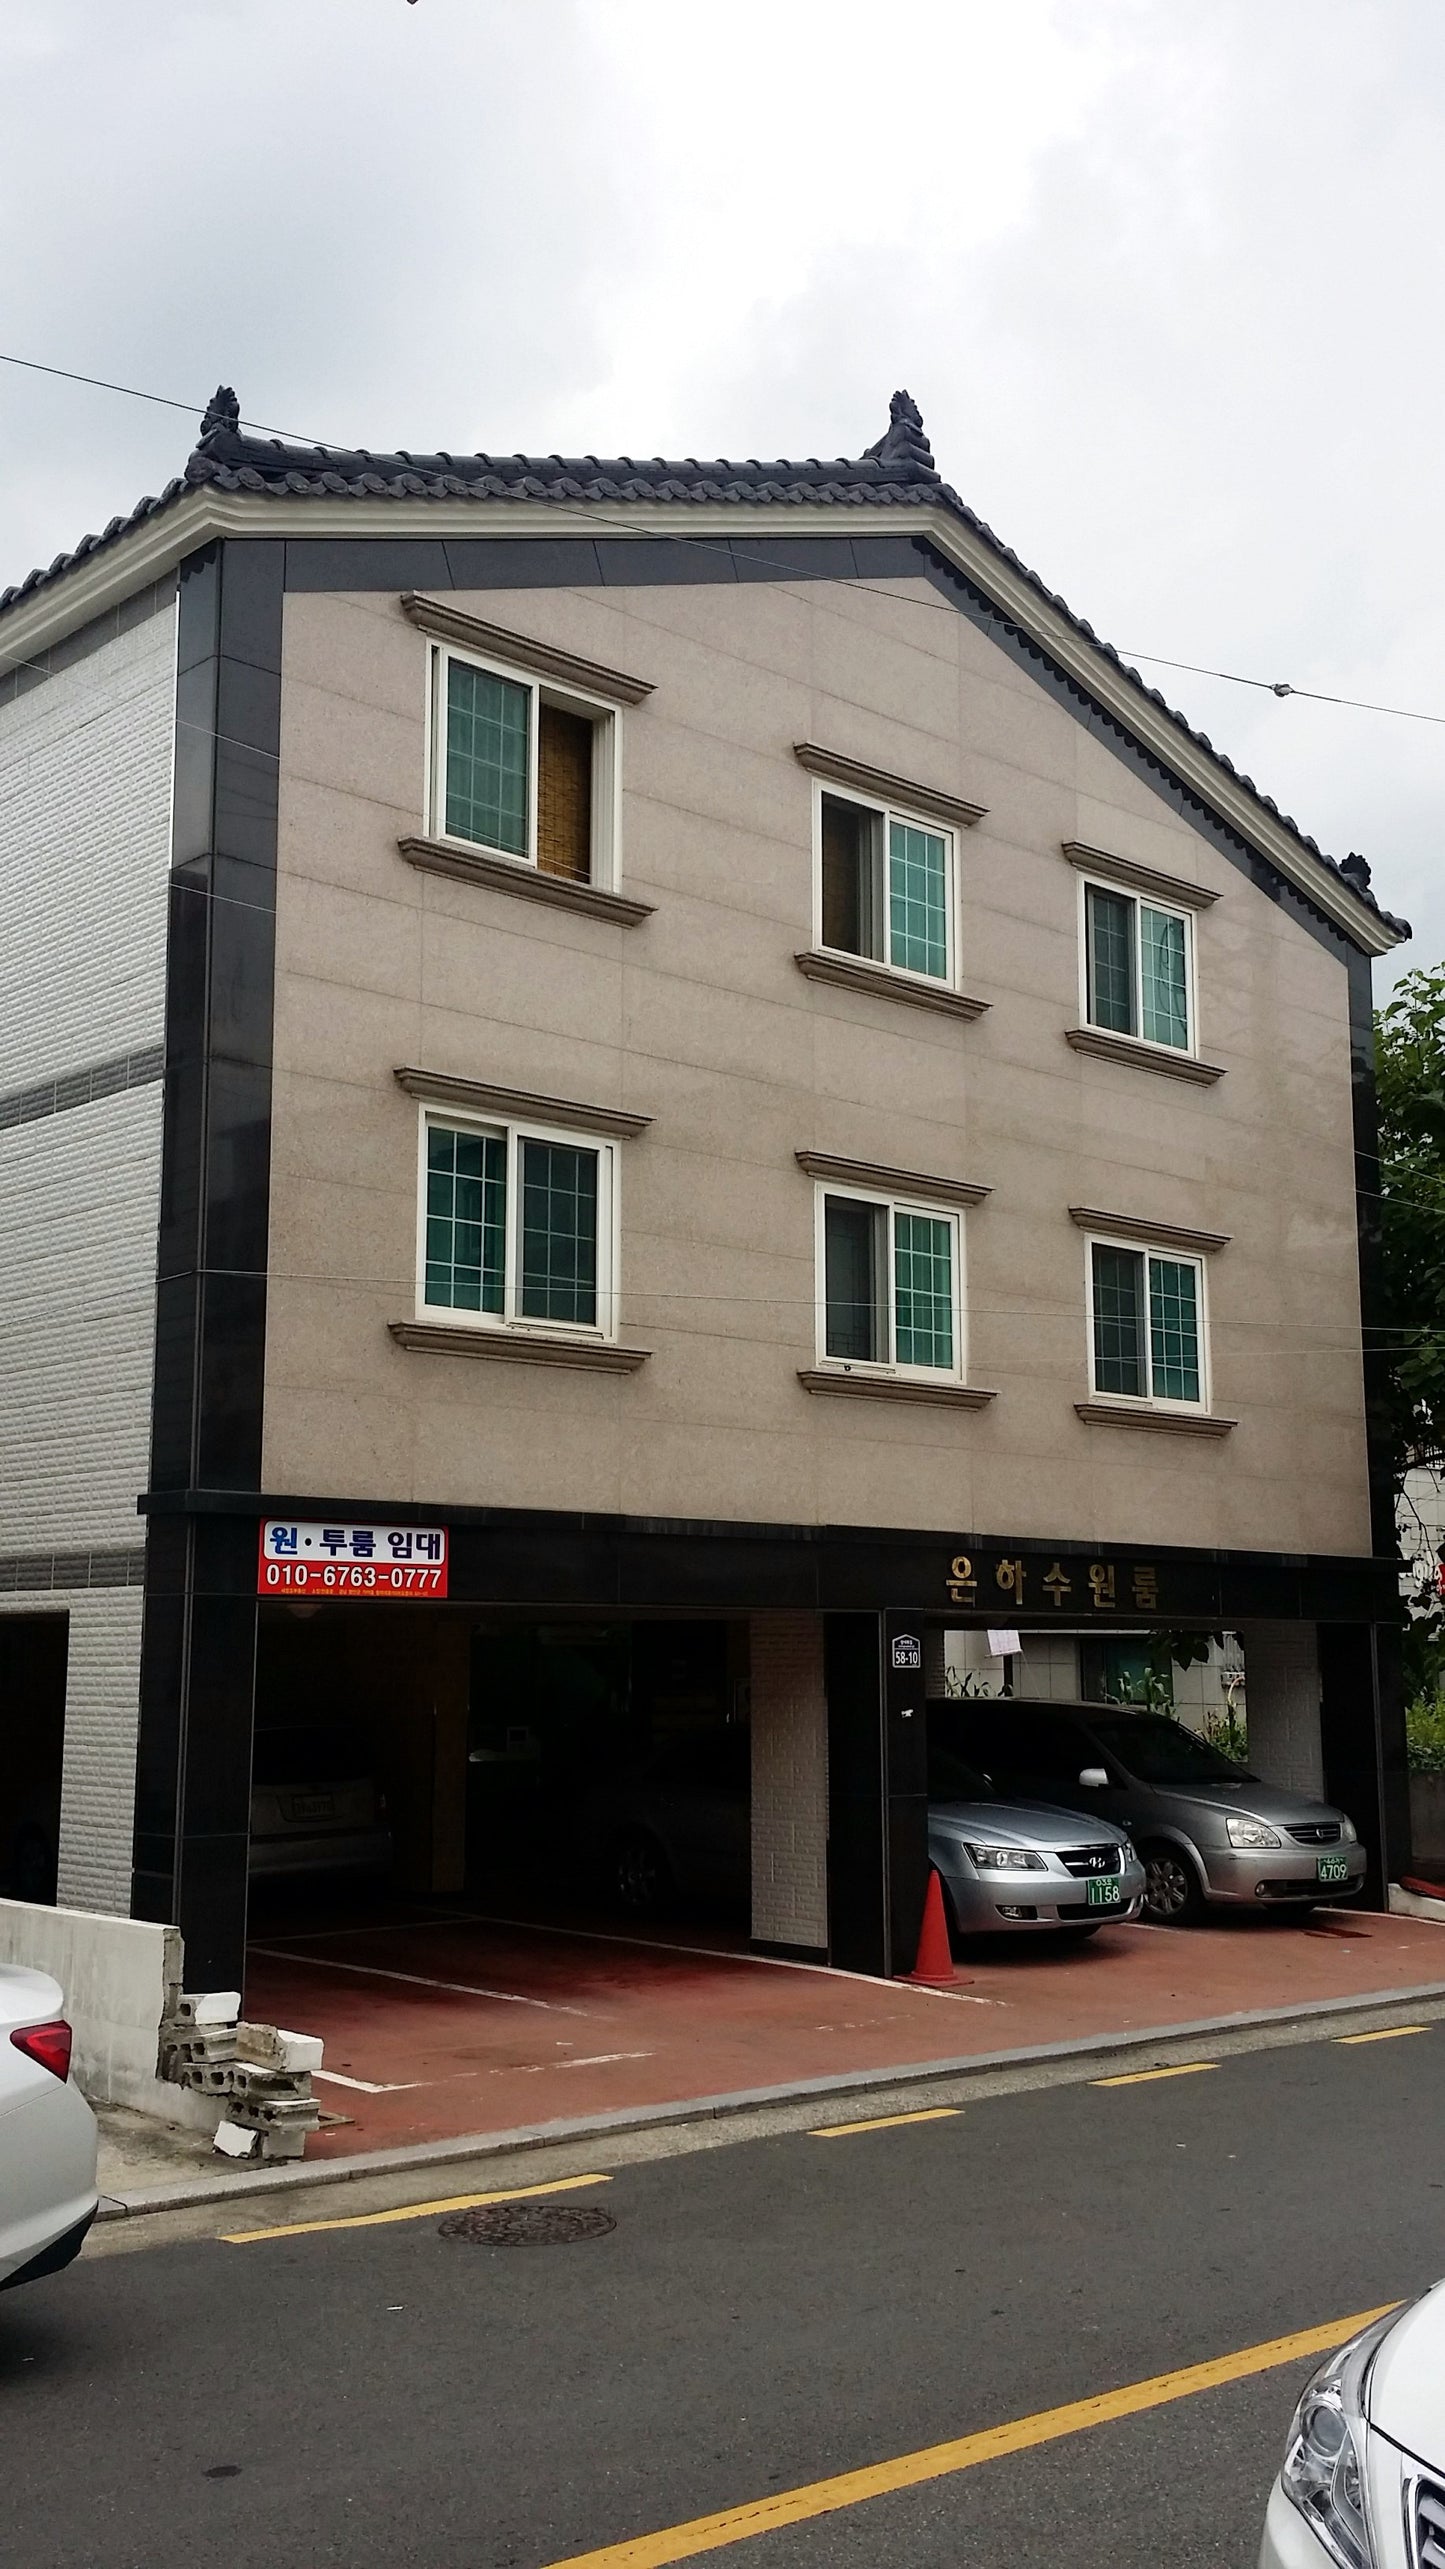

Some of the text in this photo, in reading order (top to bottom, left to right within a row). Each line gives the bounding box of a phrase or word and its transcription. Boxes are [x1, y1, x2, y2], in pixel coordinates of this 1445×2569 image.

[387, 1531, 441, 1560] 임대
[266, 1564, 442, 1589] 010-6763-0777
[895, 1651, 918, 1664] 58-10
[1320, 1864, 1347, 1880] 4709
[1091, 1885, 1120, 1904] 1158
